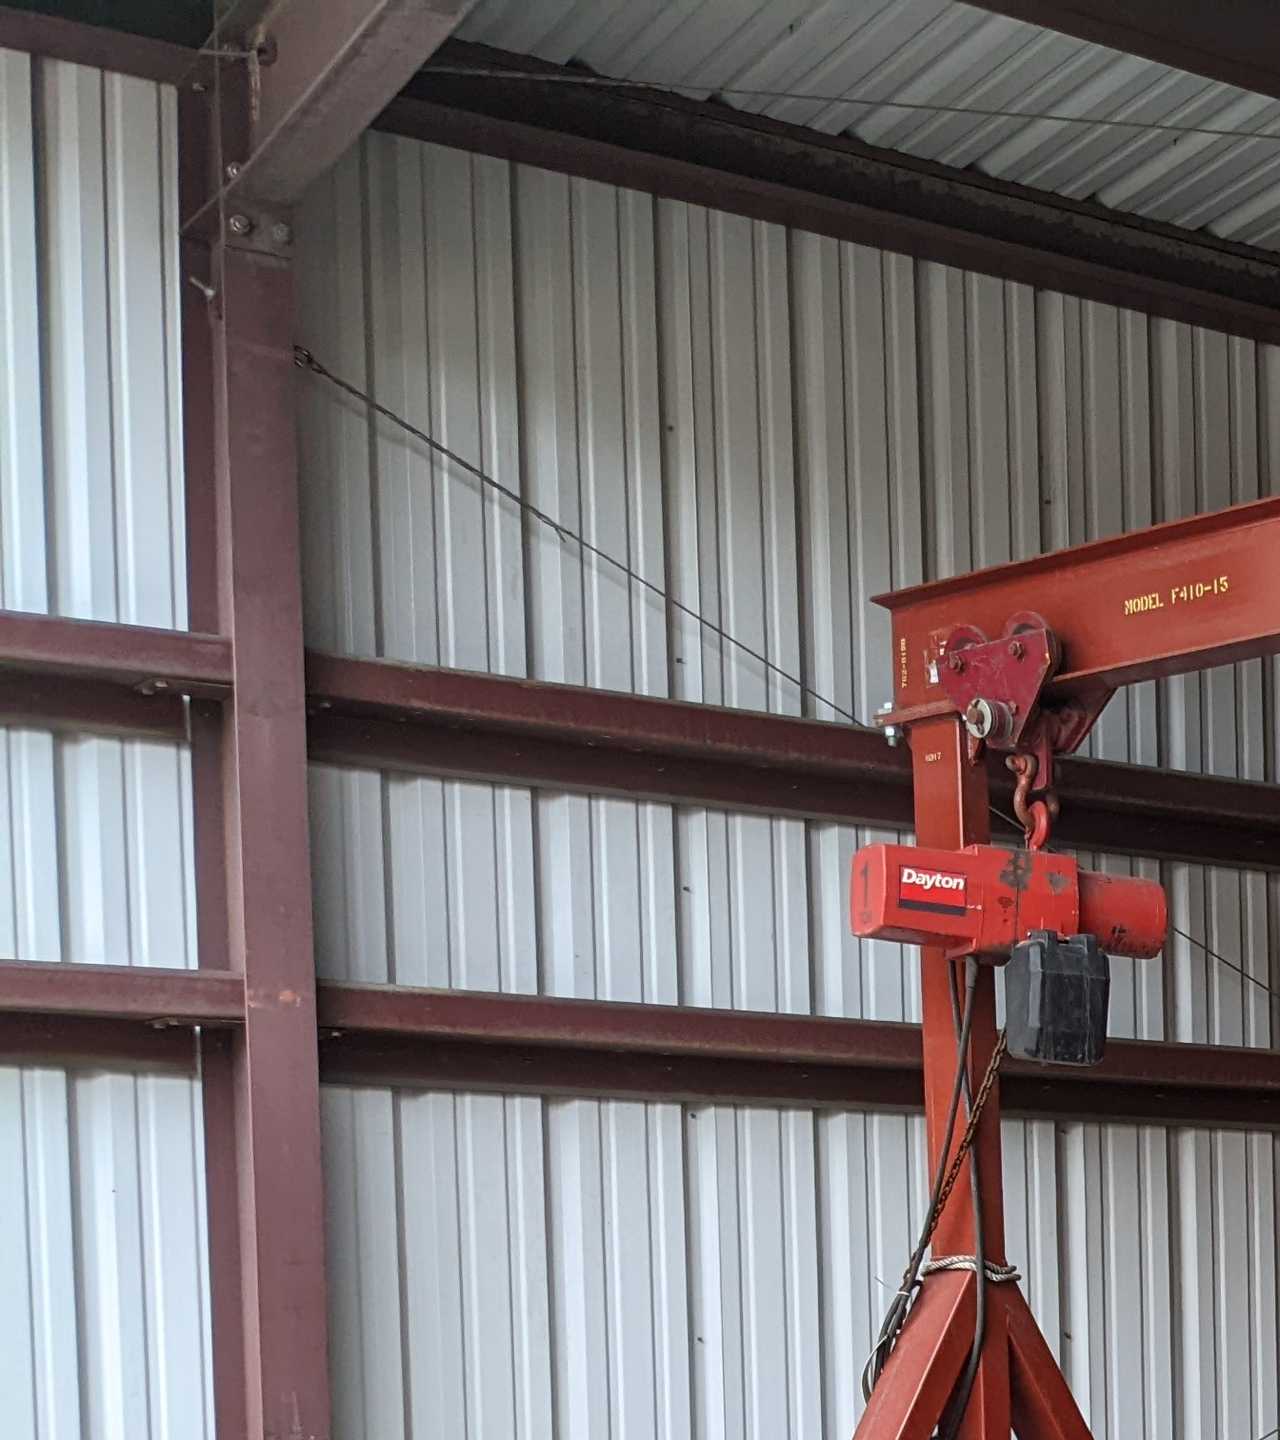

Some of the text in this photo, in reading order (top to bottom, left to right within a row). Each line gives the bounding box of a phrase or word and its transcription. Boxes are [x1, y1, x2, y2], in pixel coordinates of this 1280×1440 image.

[1124, 576, 1229, 615] MODEL F410-15
[901, 867, 965, 891] Dayton
